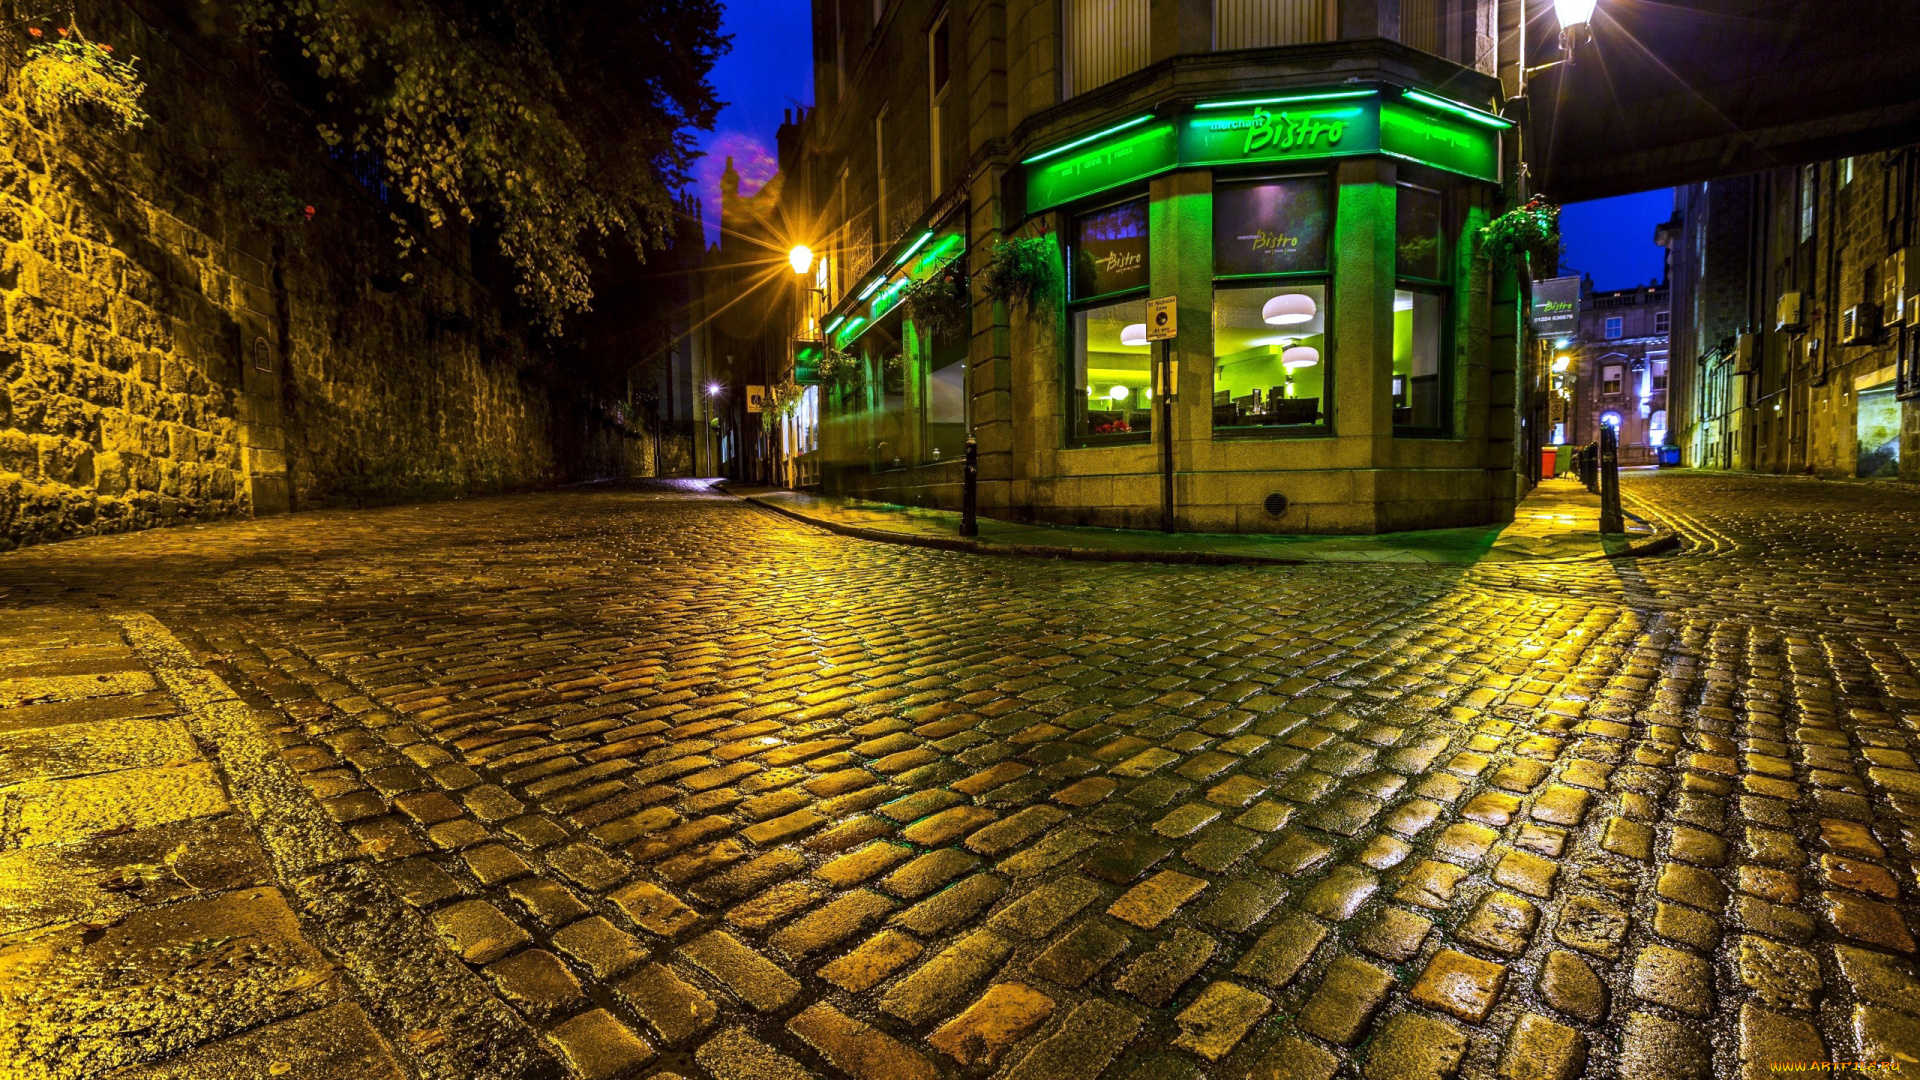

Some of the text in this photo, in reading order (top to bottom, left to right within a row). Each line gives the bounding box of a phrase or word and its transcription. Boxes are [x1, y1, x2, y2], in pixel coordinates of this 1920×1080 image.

[1210, 107, 1349, 153] merchant Bistro
[1084, 157, 1102, 169] drink
[1114, 146, 1133, 159] relax
[1252, 229, 1298, 250] Bistro
[1106, 251, 1141, 272] Bistro
[1544, 300, 1572, 312] Bistro
